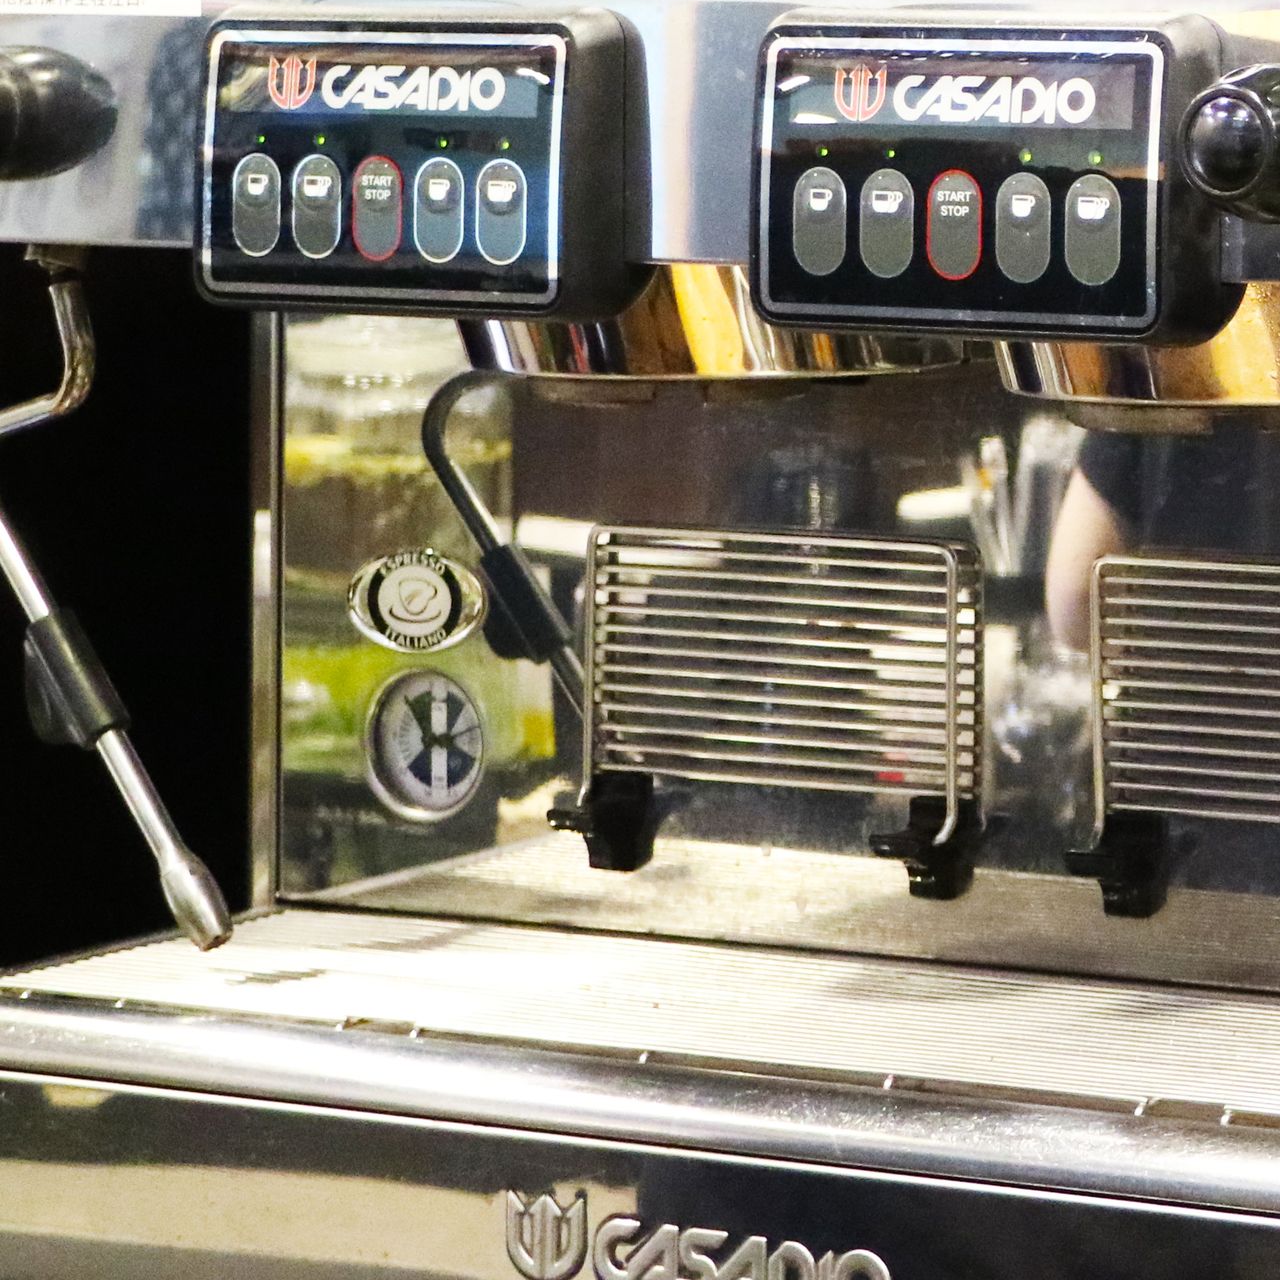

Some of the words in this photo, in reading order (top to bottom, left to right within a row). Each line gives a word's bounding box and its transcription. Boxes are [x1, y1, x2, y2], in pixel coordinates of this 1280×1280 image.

[320, 64, 506, 112] CASADIO
[892, 75, 1097, 125] CASADIO
[361, 174, 394, 188] START
[364, 188, 392, 201] STOP
[936, 190, 971, 202] START
[940, 205, 970, 217] STOP
[380, 551, 446, 577] ESPRESSO
[385, 627, 447, 650] ITALIANO
